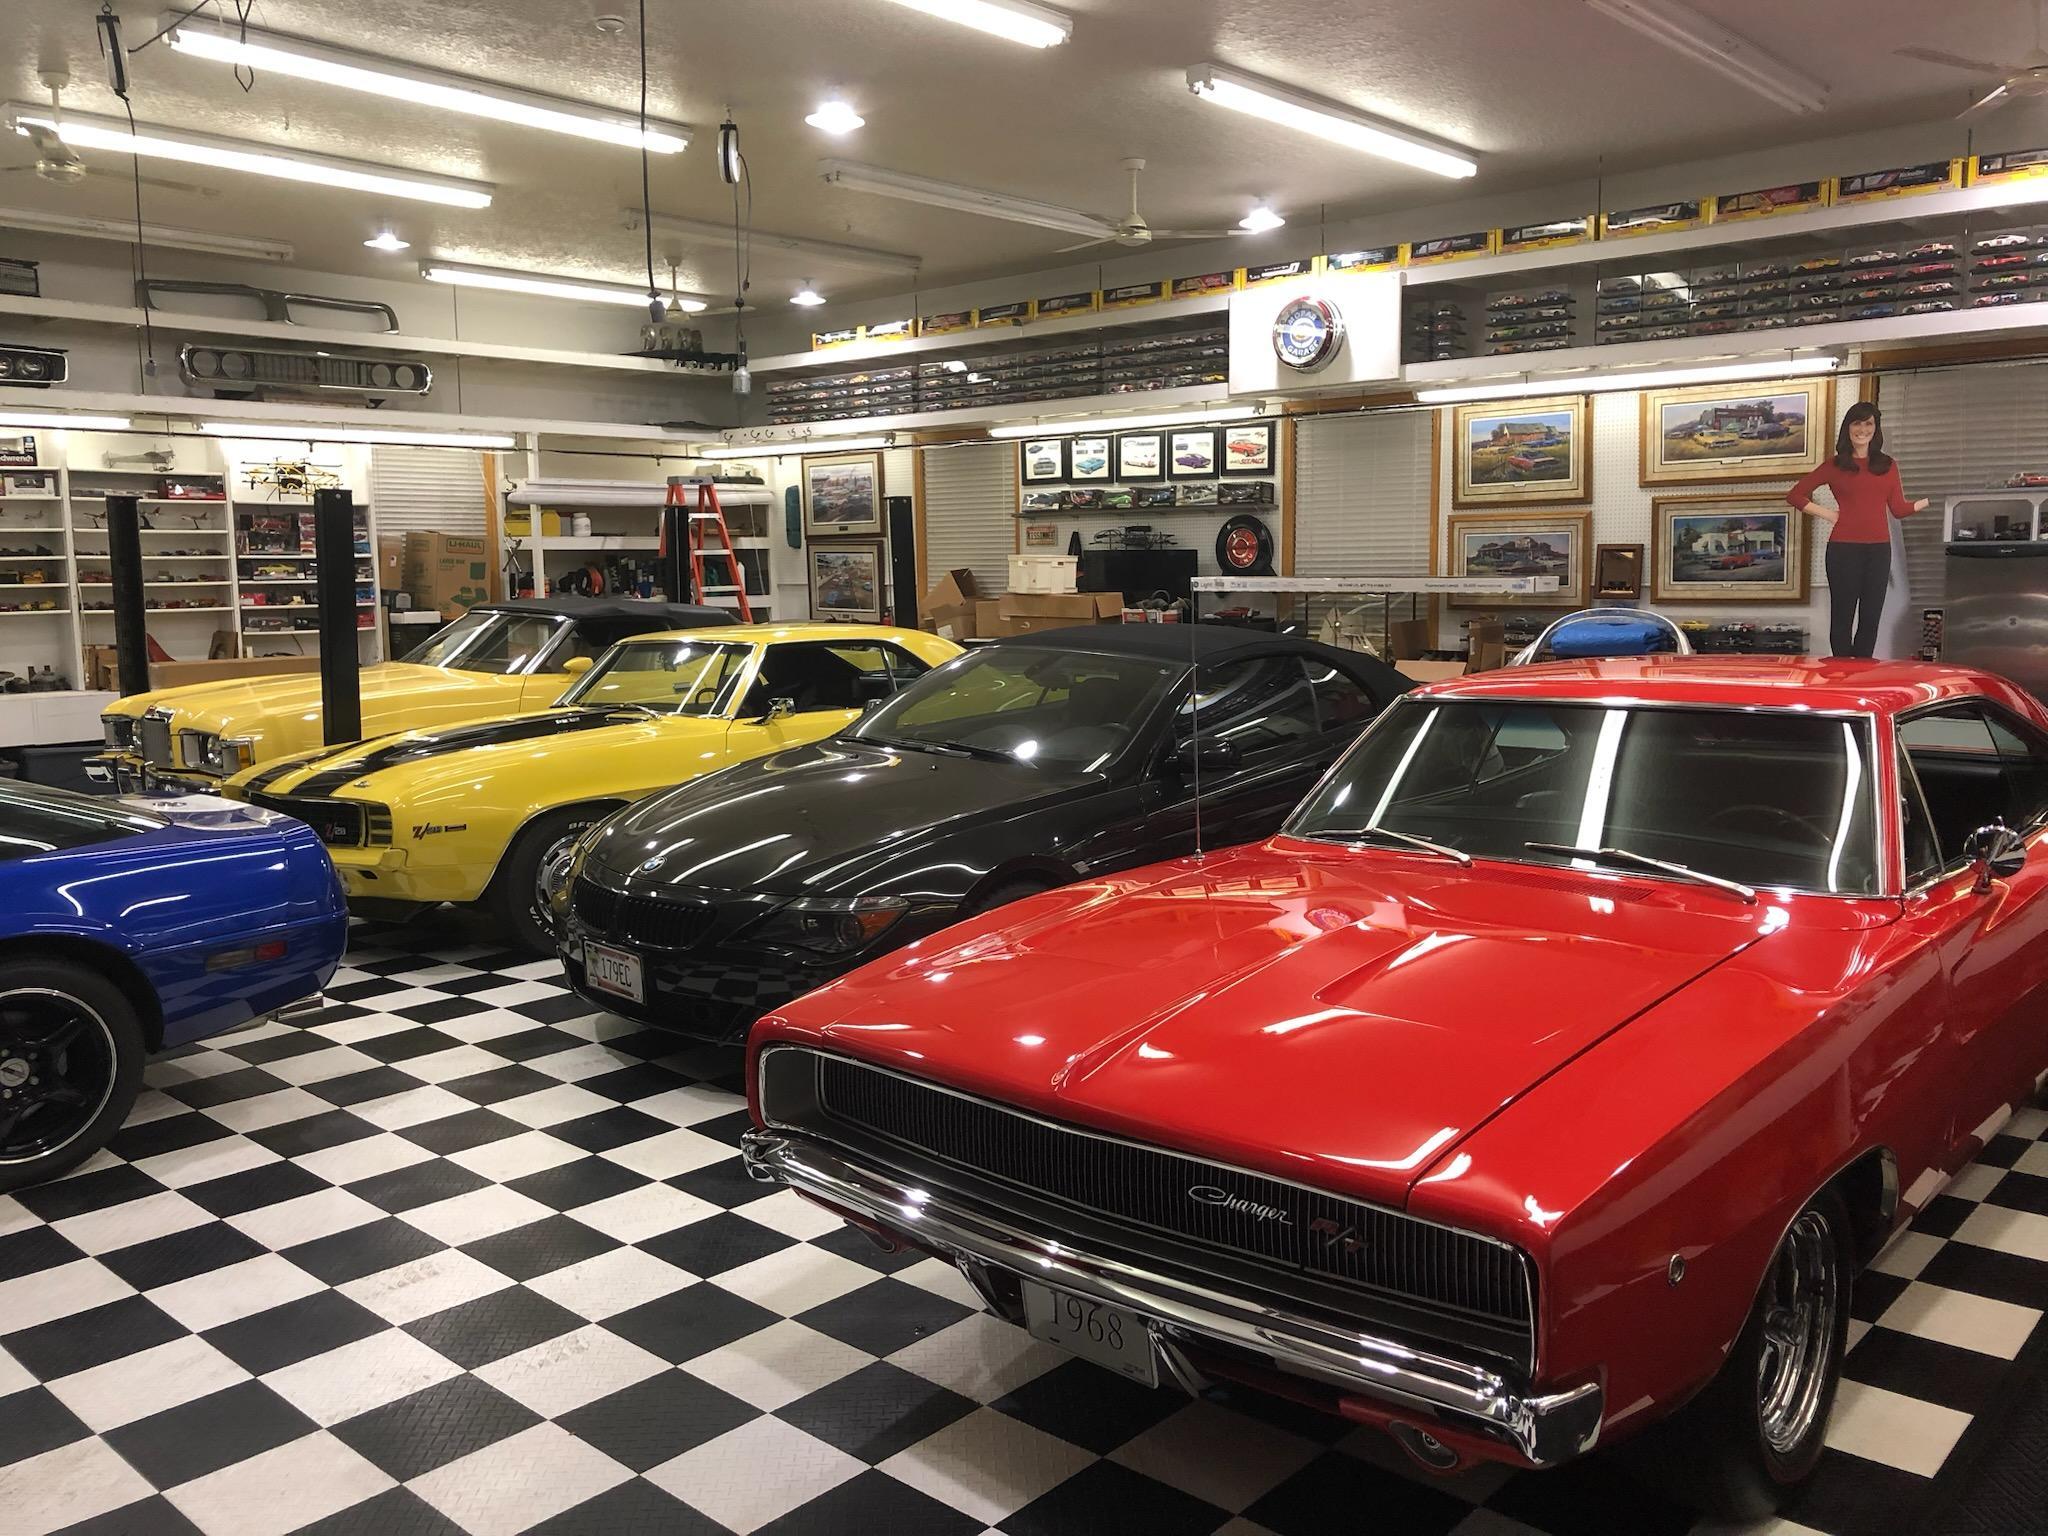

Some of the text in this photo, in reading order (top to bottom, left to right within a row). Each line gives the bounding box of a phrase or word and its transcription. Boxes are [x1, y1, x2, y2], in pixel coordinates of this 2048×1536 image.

[1287, 310, 1318, 326] MOPAR
[1287, 339, 1320, 356] GARAGE
[1187, 1185, 1294, 1226] Charger
[1049, 1290, 1124, 1350] 1968
